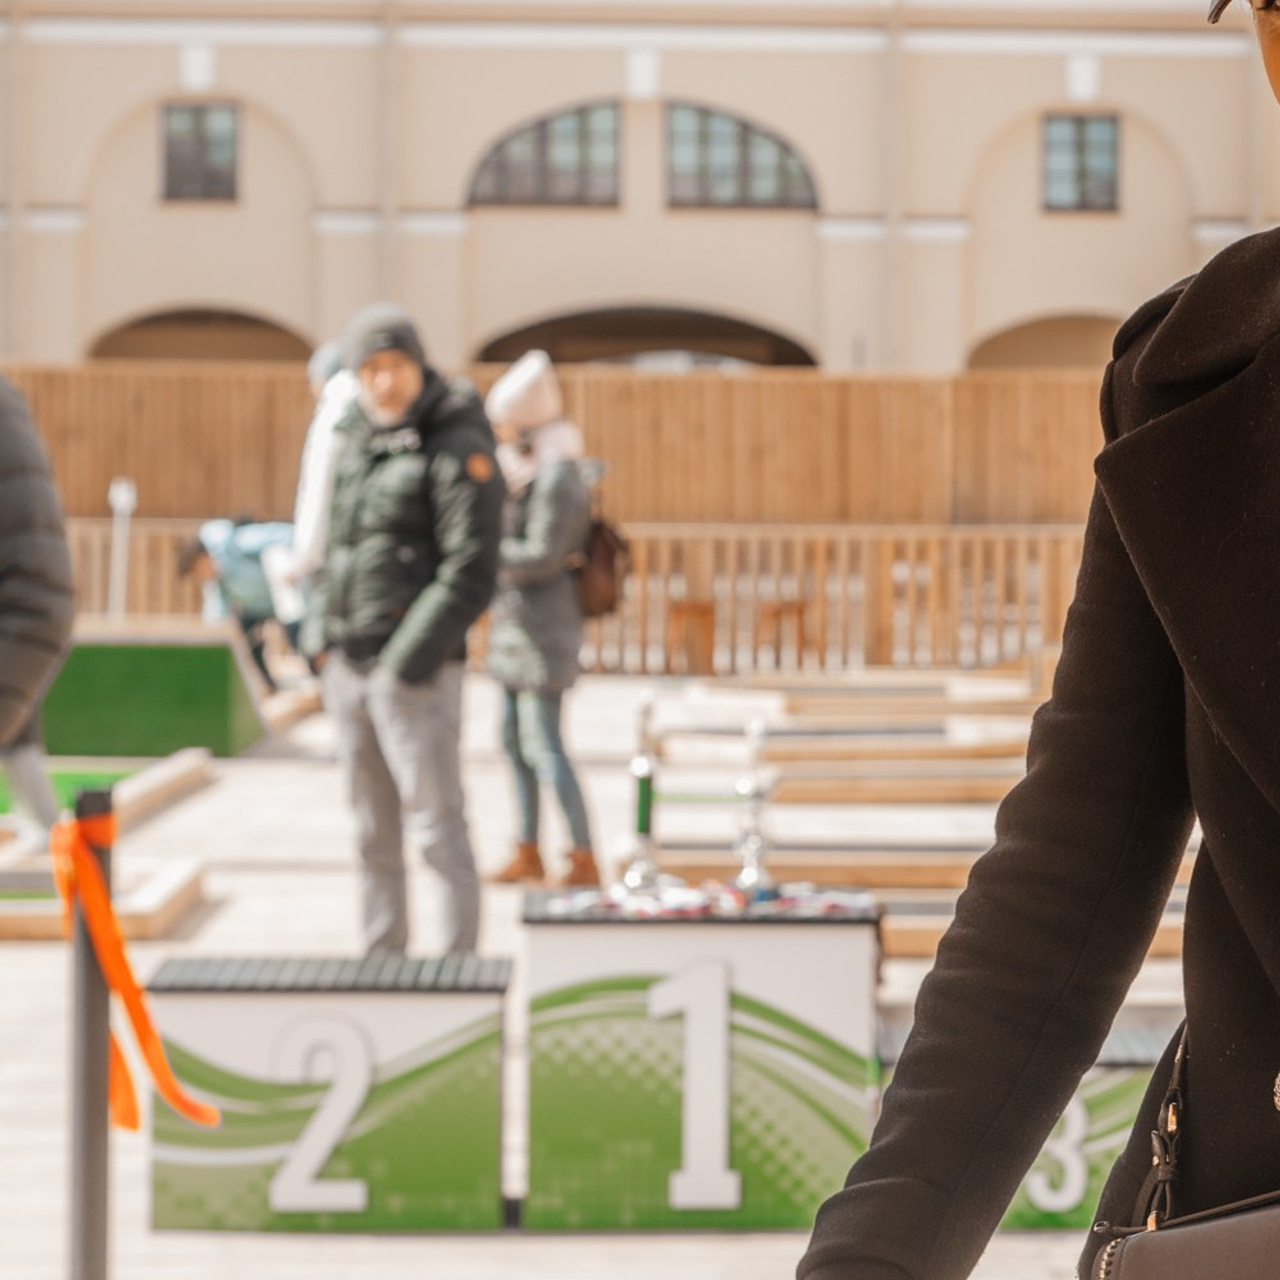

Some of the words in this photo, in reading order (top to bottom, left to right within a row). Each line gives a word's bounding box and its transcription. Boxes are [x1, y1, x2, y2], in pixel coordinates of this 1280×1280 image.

[269, 1011, 374, 1213] 2
[645, 958, 741, 1211] 1
[1026, 1092, 1088, 1213] 3
